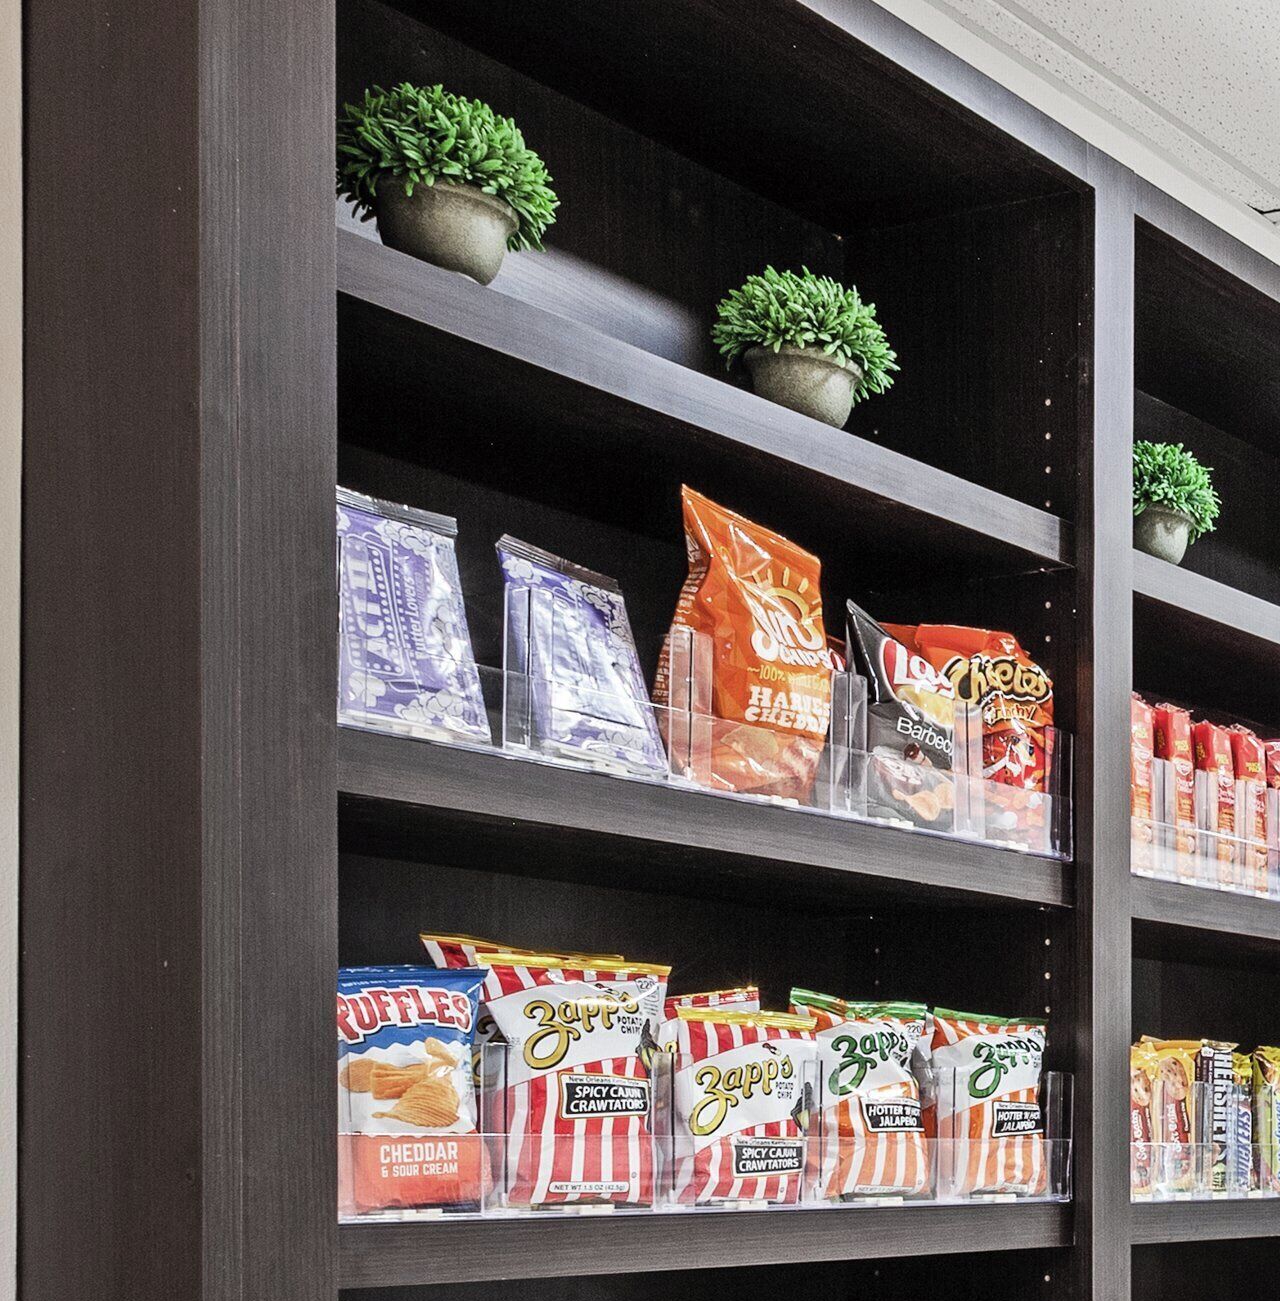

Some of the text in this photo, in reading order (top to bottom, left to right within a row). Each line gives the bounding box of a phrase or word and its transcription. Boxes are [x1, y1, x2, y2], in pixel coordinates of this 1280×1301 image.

[402, 576, 420, 617] Lovers
[352, 594, 389, 661] ACT
[338, 987, 472, 1040] RUFFLES
[574, 1085, 641, 1099] SPICY CAJUN
[570, 1099, 645, 1113] CRAWTATORS
[868, 1105, 903, 1116] HOTTER
[380, 1142, 458, 1164] CHEDDAR
[741, 1147, 797, 1160] SPICY CAJUN
[1237, 1108, 1252, 1188] SNICKERS
[392, 1164, 419, 1177] SOUR
[422, 1161, 458, 1175] CREAM
[739, 1158, 799, 1172] CRAWTATORS
